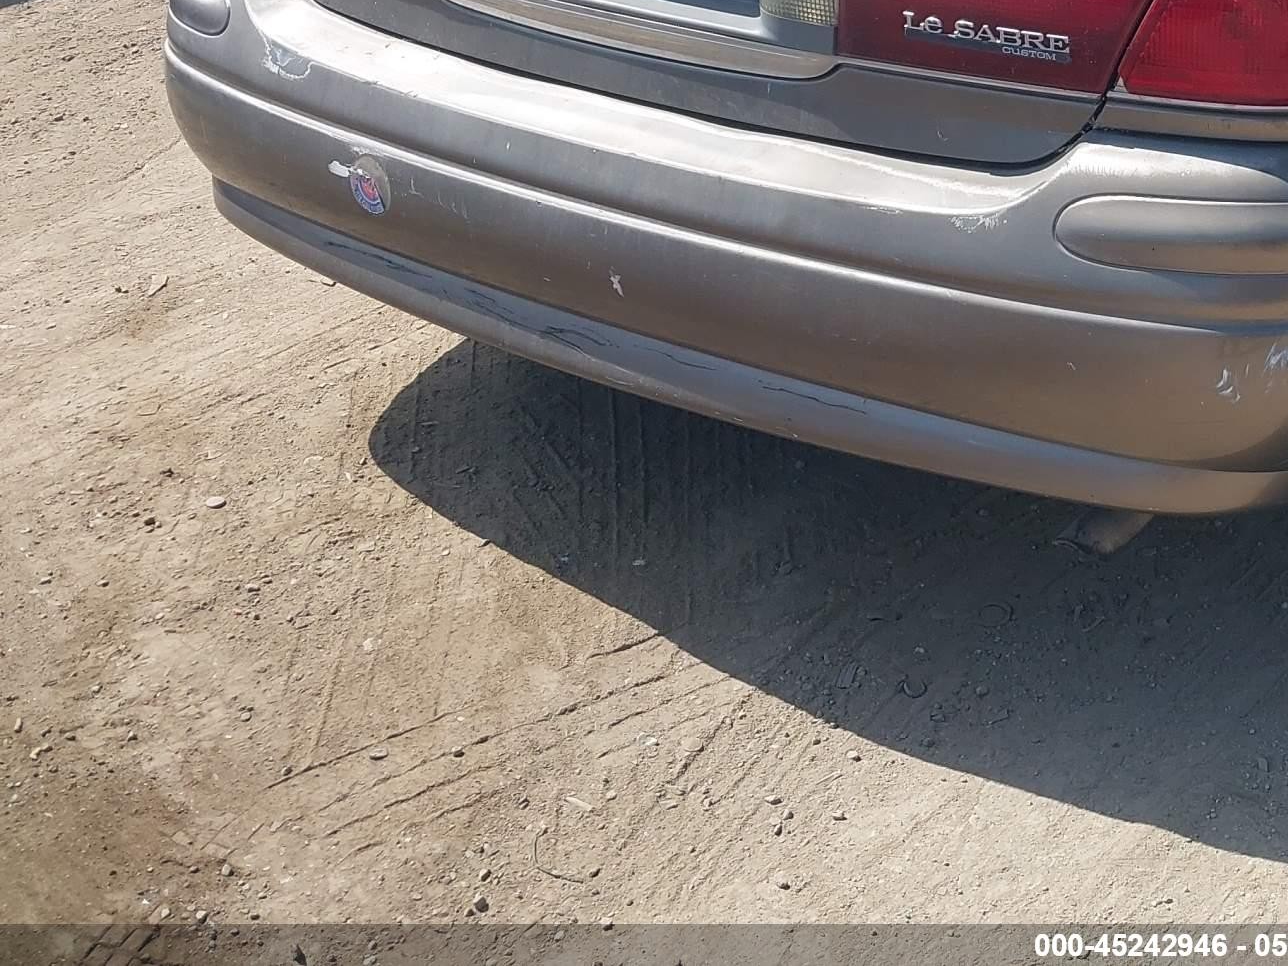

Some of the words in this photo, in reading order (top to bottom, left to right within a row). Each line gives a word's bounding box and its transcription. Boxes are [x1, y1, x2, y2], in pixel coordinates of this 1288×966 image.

[902, 10, 943, 34] Le
[953, 19, 1070, 54] SABRE
[1001, 46, 1057, 61] CUSTOM
